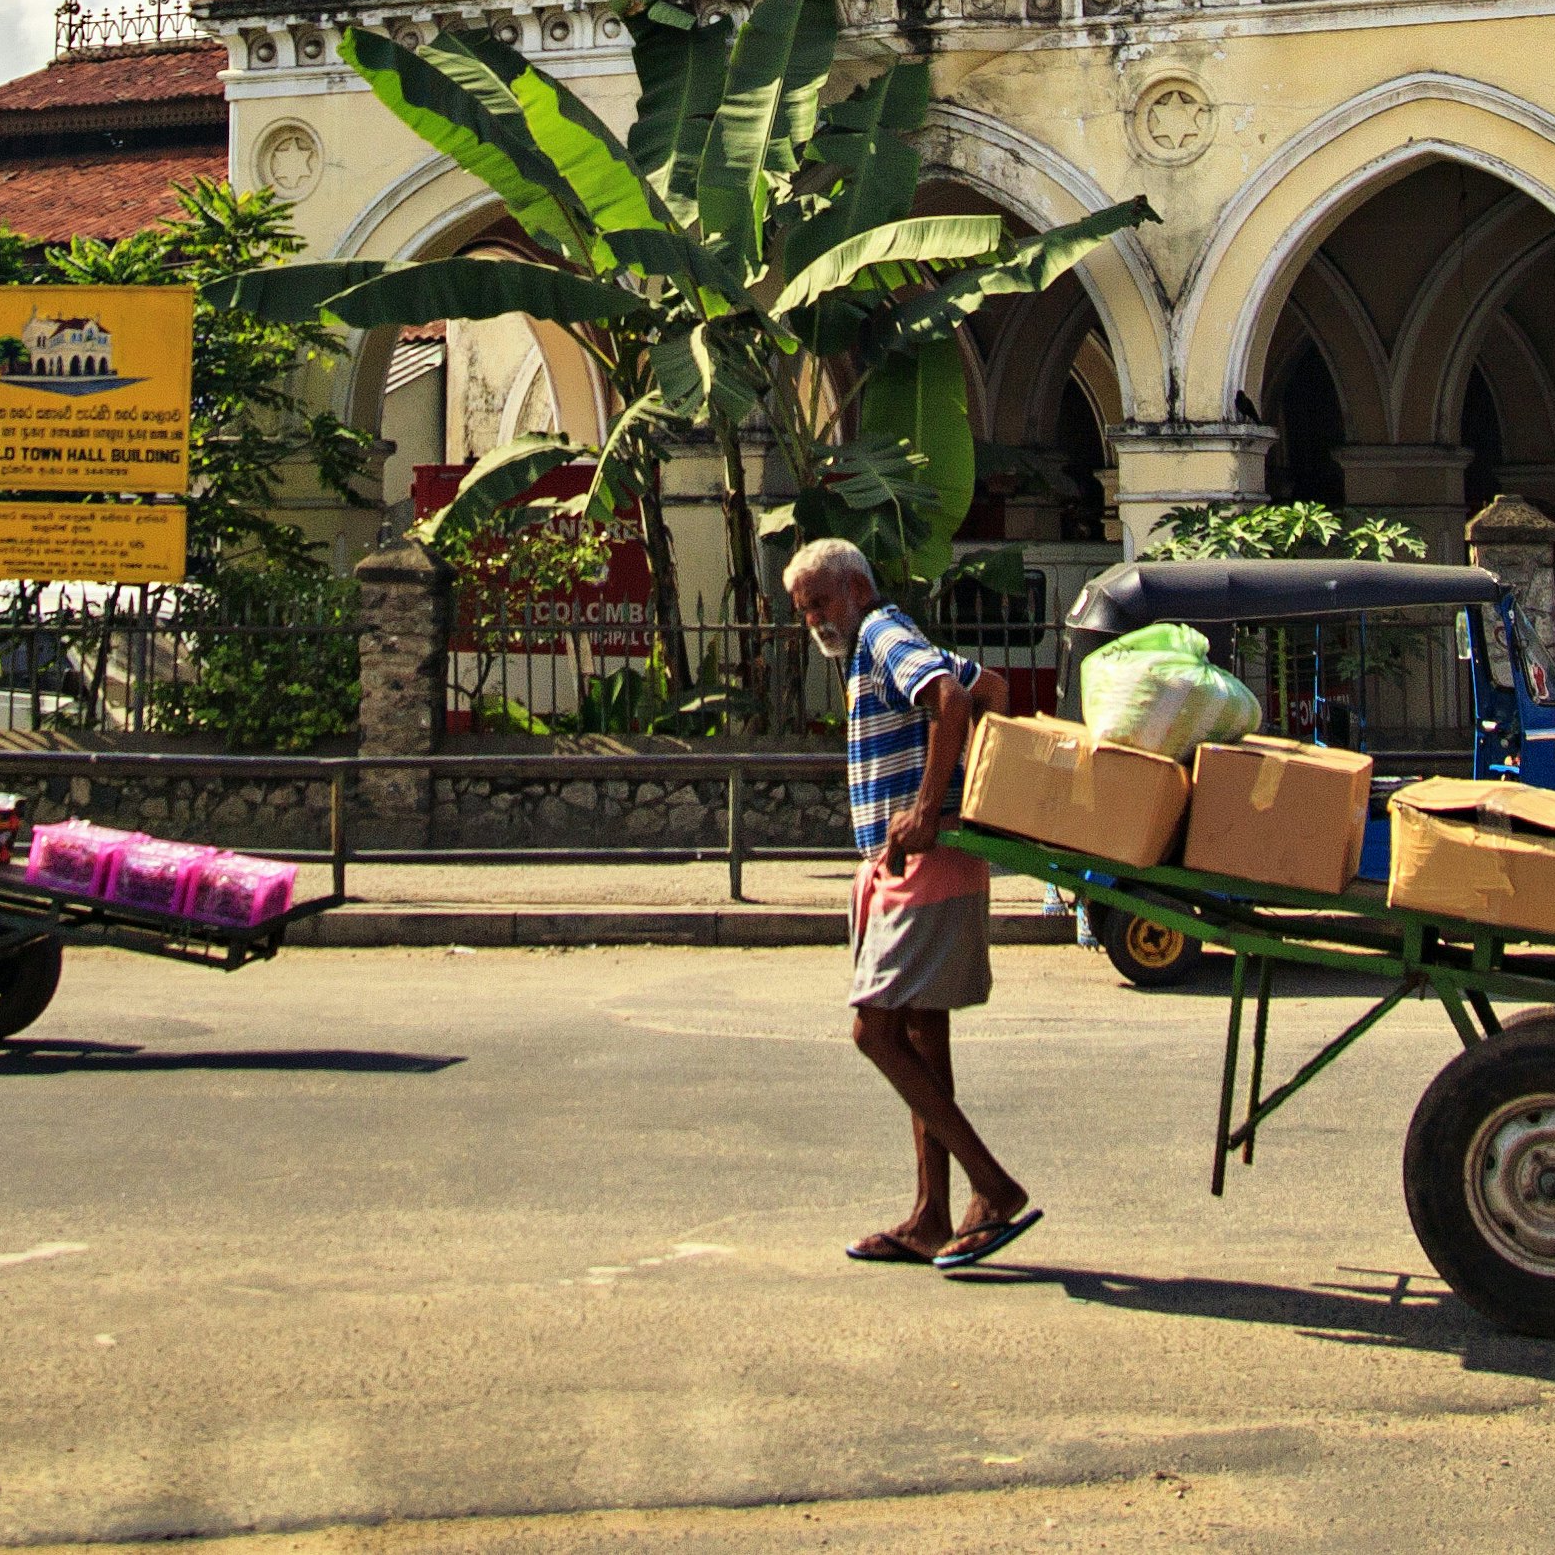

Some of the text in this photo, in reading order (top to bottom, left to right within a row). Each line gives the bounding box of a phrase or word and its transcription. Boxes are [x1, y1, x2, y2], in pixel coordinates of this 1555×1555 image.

[21, 447, 63, 461] TOWN
[66, 448, 106, 462] HALL
[111, 448, 181, 464] BUILDING
[535, 602, 651, 623] COLOMB
